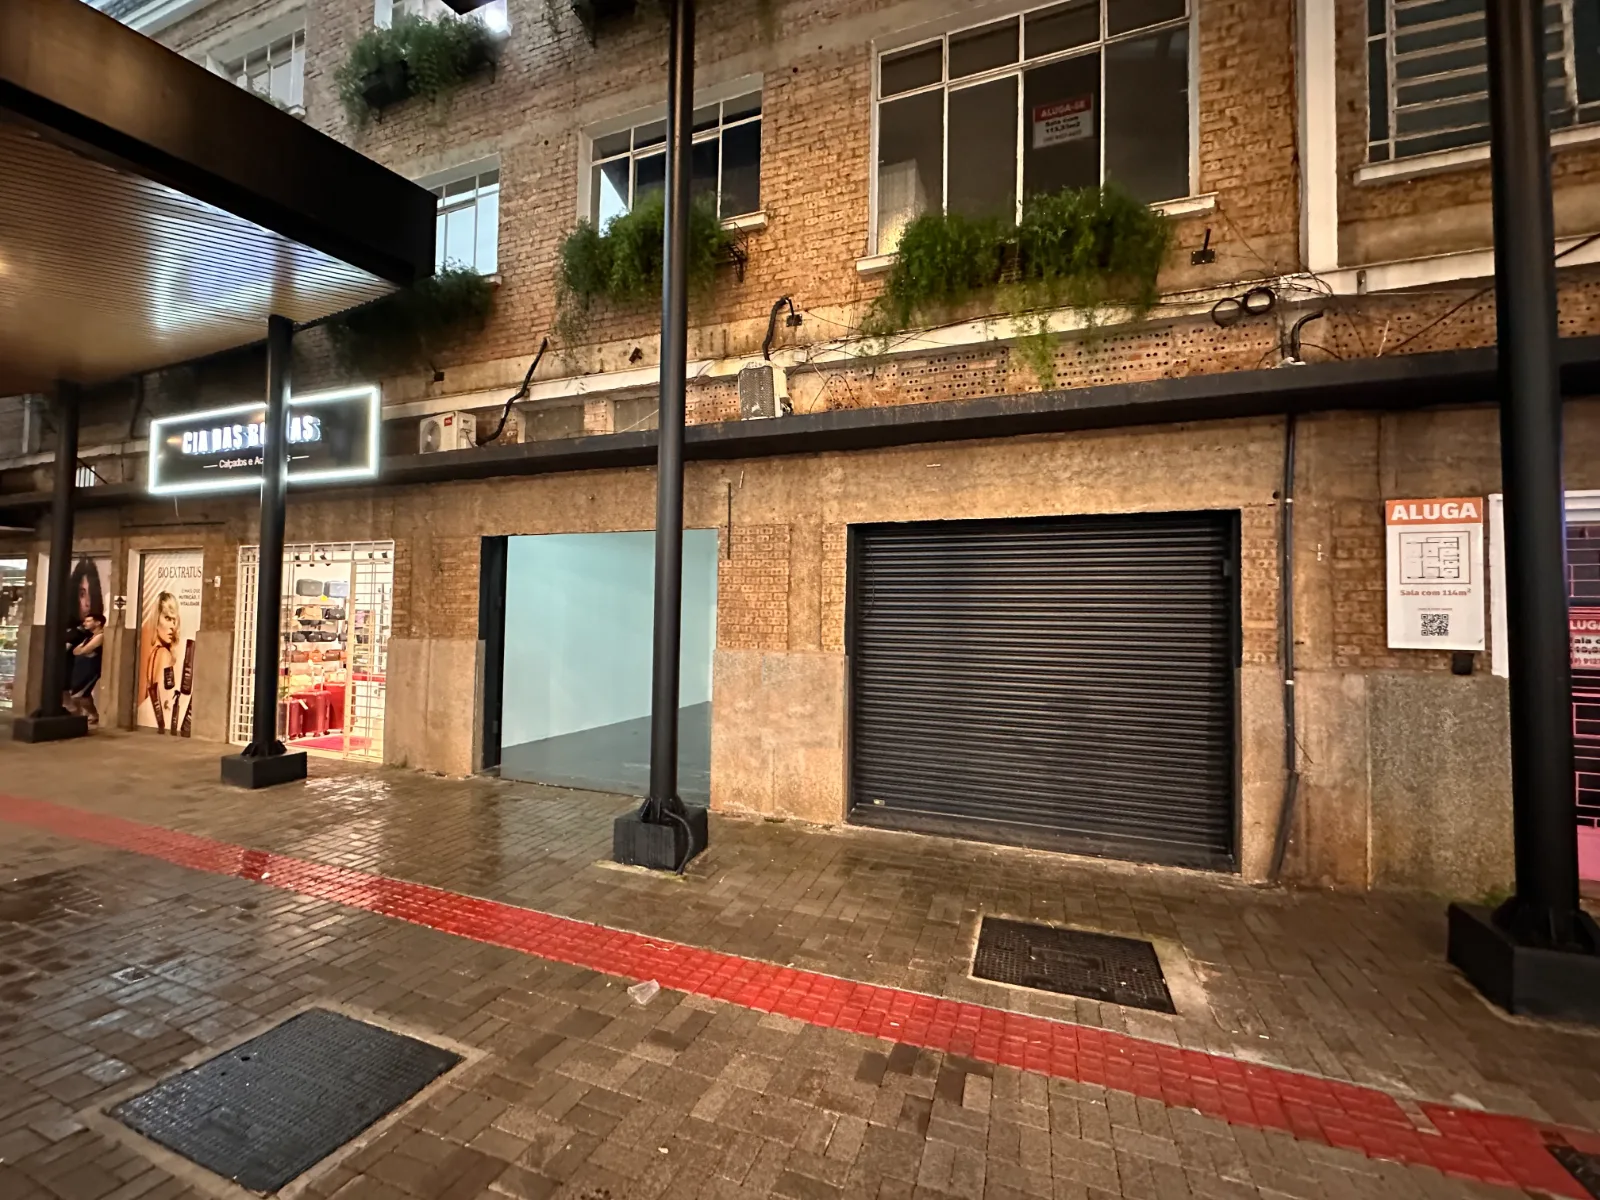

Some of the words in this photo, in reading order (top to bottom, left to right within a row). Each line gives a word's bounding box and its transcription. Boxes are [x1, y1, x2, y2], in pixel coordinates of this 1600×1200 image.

[182, 430, 208, 454] CIA
[211, 425, 243, 452] DAS
[247, 415, 321, 447] BOAS
[219, 458, 248, 469] Calçados
[1391, 502, 1478, 520] ALUGA
[158, 566, 169, 578] BIO
[169, 566, 202, 578] EXTRATUS
[1570, 620, 1600, 630] LUG
